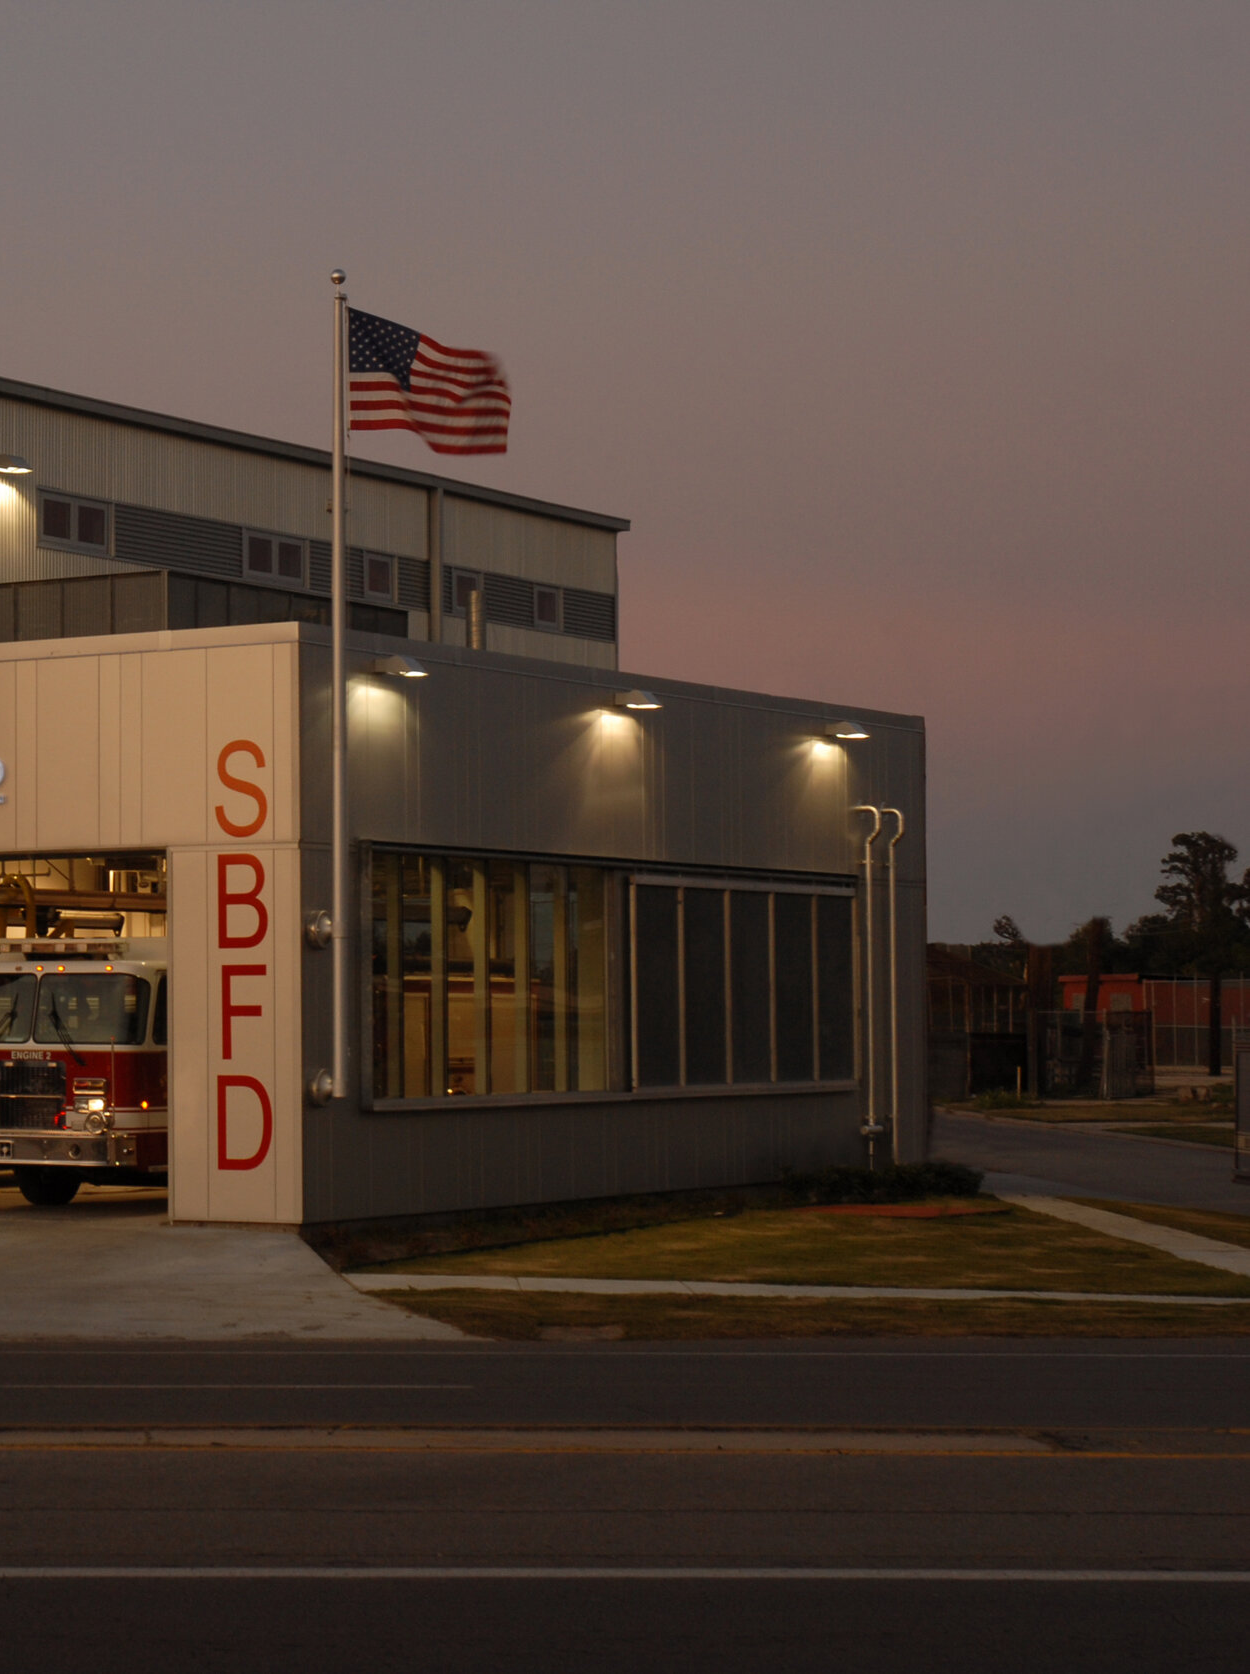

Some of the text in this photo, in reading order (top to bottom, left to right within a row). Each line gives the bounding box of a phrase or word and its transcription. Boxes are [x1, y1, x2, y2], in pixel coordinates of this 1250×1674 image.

[11, 1051, 52, 1060] ENGINE 2
[215, 740, 272, 1170] SBFD
